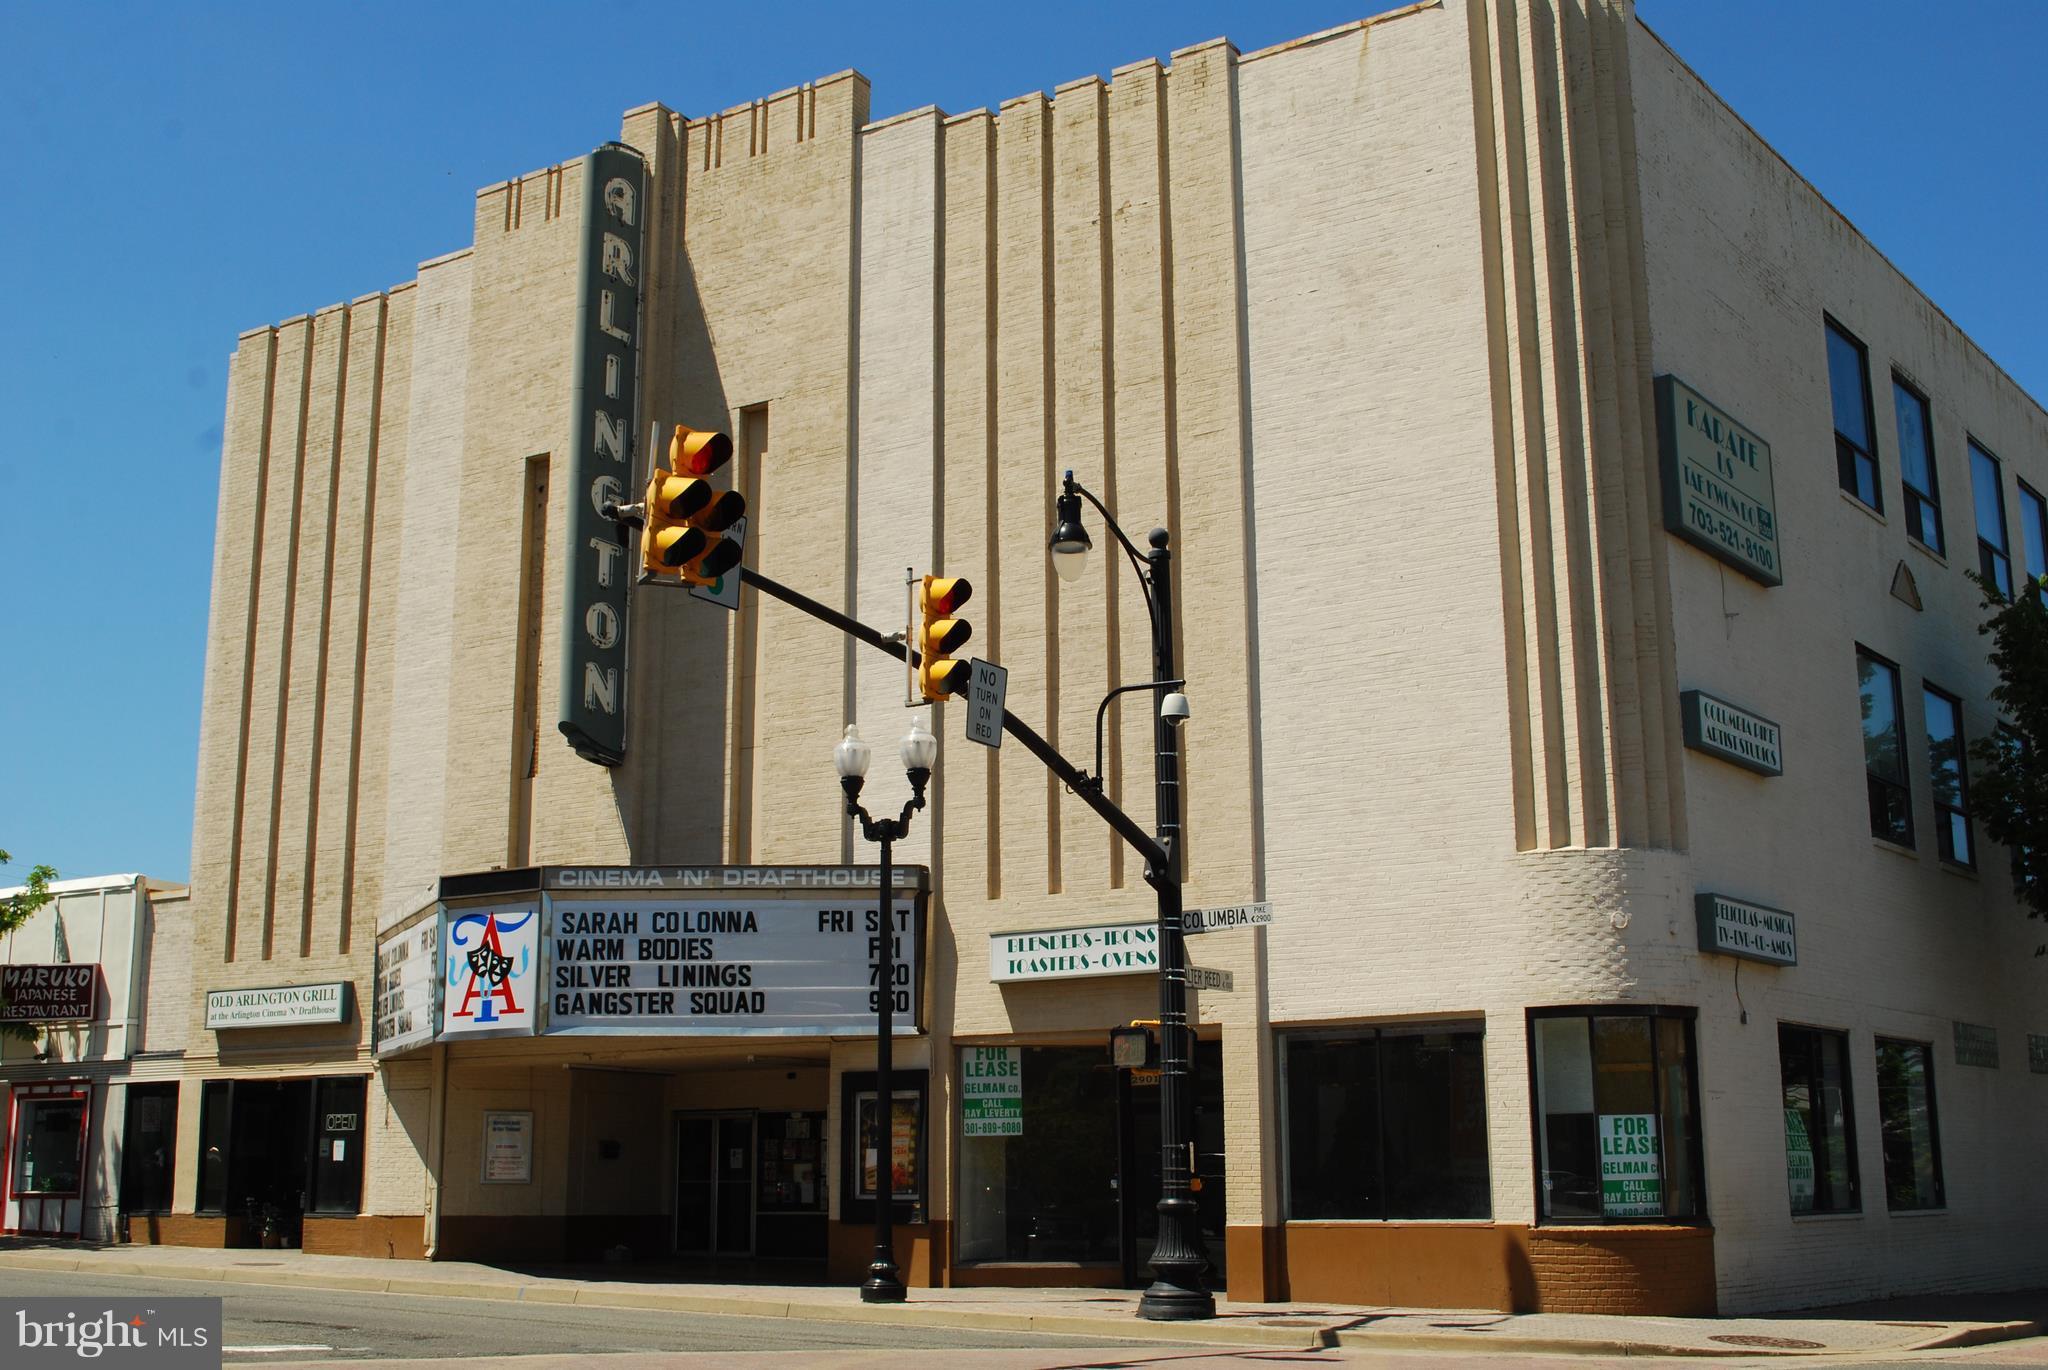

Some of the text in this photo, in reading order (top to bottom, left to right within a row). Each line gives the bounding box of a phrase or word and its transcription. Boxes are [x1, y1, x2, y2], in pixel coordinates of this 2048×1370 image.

[1686, 399, 1759, 472] KARATE
[584, 177, 636, 715] ARLINGTON
[1689, 502, 1773, 570] 703-521-8100
[980, 667, 996, 686] NO
[976, 687, 998, 705] TURN
[980, 706, 991, 720] ON
[976, 722, 992, 738] RED
[1704, 702, 1775, 745] COLUMBIA PIKE
[1706, 725, 1777, 766] ARTIST STUDIOS
[559, 870, 664, 886] CINEMA
[723, 869, 904, 886] DRAFTHOUSE
[562, 910, 910, 934] SARAH COLONNA FRI ST
[1183, 908, 1248, 929] COLUMBIA
[557, 937, 901, 961] WARM BODIES FI
[3, 968, 91, 988] MARUKO
[556, 965, 631, 988] SILVER
[658, 964, 751, 988] LININGS
[1204, 971, 1220, 988] REED
[14, 988, 77, 1002] JAPANESE
[211, 988, 337, 1009] OLD ARLINGTON GRILL
[555, 991, 674, 1016] GANGSTER
[690, 991, 765, 1015] SQUAD
[3, 1004, 88, 1018] RESTAURANT
[210, 1013, 217, 1021] at
[218, 1011, 229, 1020] the
[230, 1010, 260, 1021] Arlington
[262, 1008, 287, 1018] Cinema
[299, 1005, 337, 1016] Drafthouse
[975, 1047, 1007, 1060] FOR
[965, 1061, 1018, 1077] LEASE
[965, 1083, 1005, 1093] GELMAN
[982, 1099, 1003, 1108] CALL
[965, 1108, 1020, 1118] RAY LEVERTY
[327, 1114, 356, 1130] OPEN
[1613, 1117, 1648, 1135] FOR
[1603, 1136, 1658, 1155] LEASE
[1603, 1161, 1648, 1174] GELMAN
[1623, 1180, 1645, 1191] CALL
[1604, 1192, 1621, 1203] RAY
